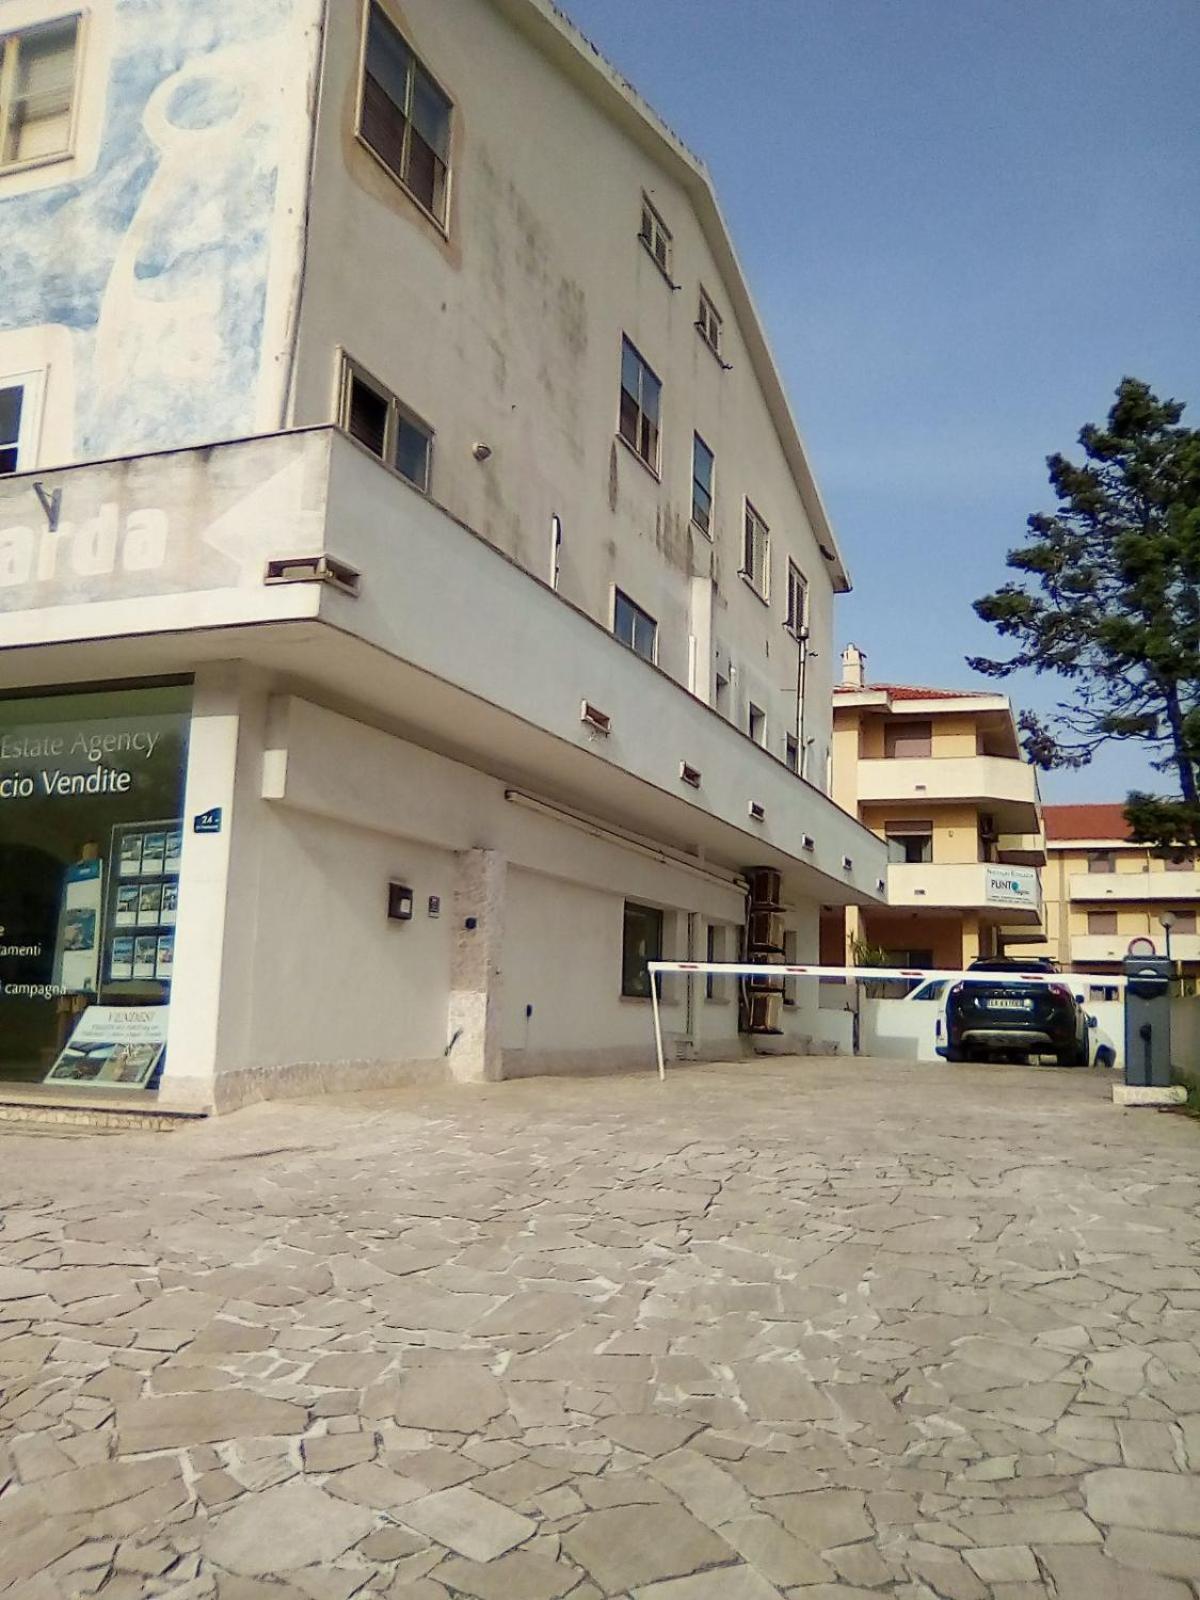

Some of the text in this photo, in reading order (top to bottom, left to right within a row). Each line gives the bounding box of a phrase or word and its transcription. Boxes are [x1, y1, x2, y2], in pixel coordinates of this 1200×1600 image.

[1, 731, 160, 762] Estate Agency
[0, 764, 131, 799] cio Vendite
[0, 942, 42, 957] amenti
[4, 982, 67, 1000] campagna
